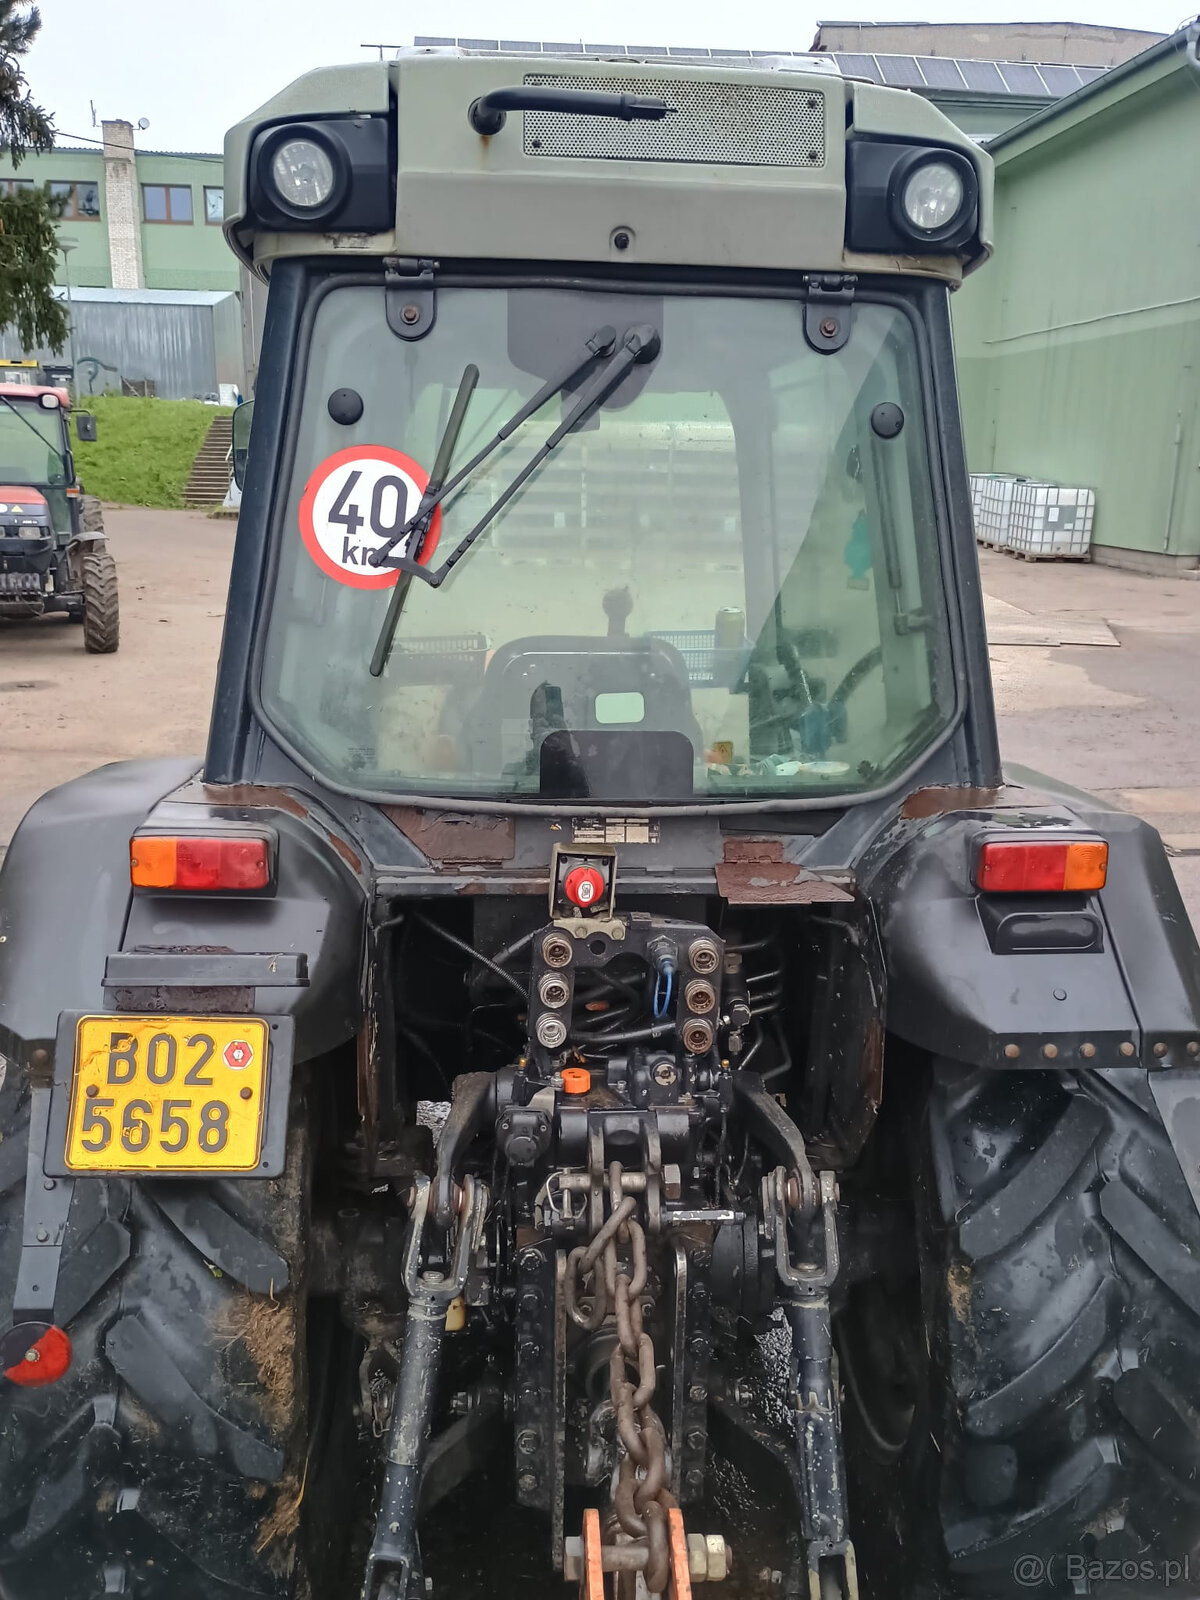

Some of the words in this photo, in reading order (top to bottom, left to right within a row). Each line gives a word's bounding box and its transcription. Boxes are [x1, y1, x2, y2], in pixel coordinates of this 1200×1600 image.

[328, 470, 408, 538] 40
[107, 1032, 216, 1086] B02
[81, 1098, 230, 1154] 5658
